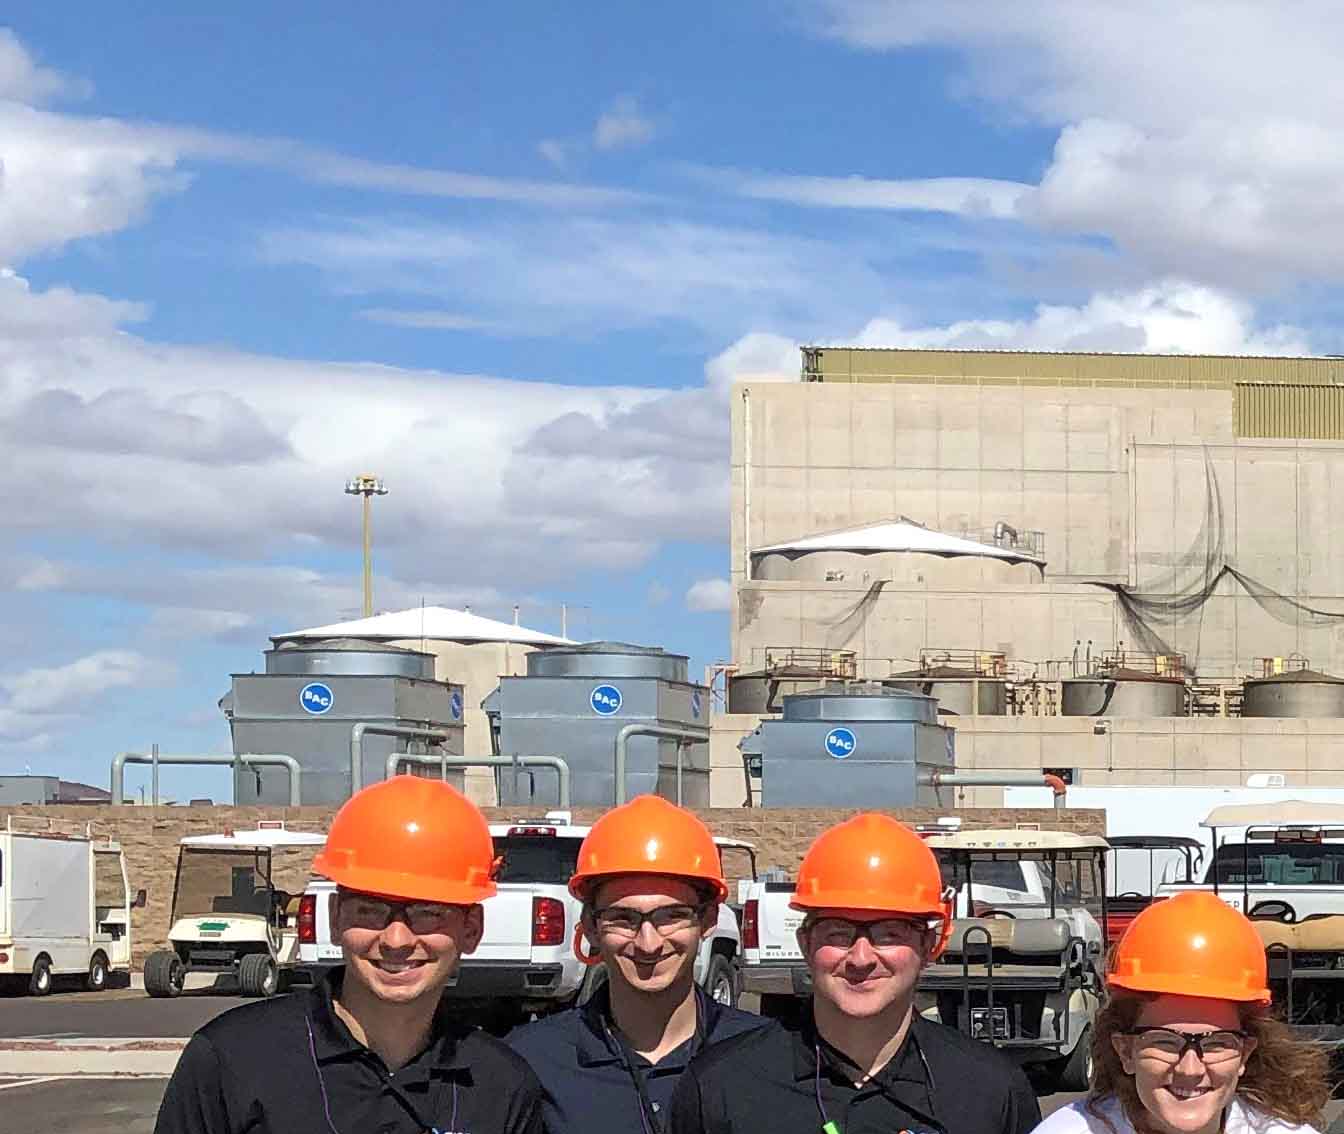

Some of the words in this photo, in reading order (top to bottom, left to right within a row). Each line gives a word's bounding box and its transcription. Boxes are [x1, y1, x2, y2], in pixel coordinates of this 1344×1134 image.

[304, 690, 329, 706] BAC
[594, 692, 618, 707] BAC
[829, 735, 852, 750] BAC
